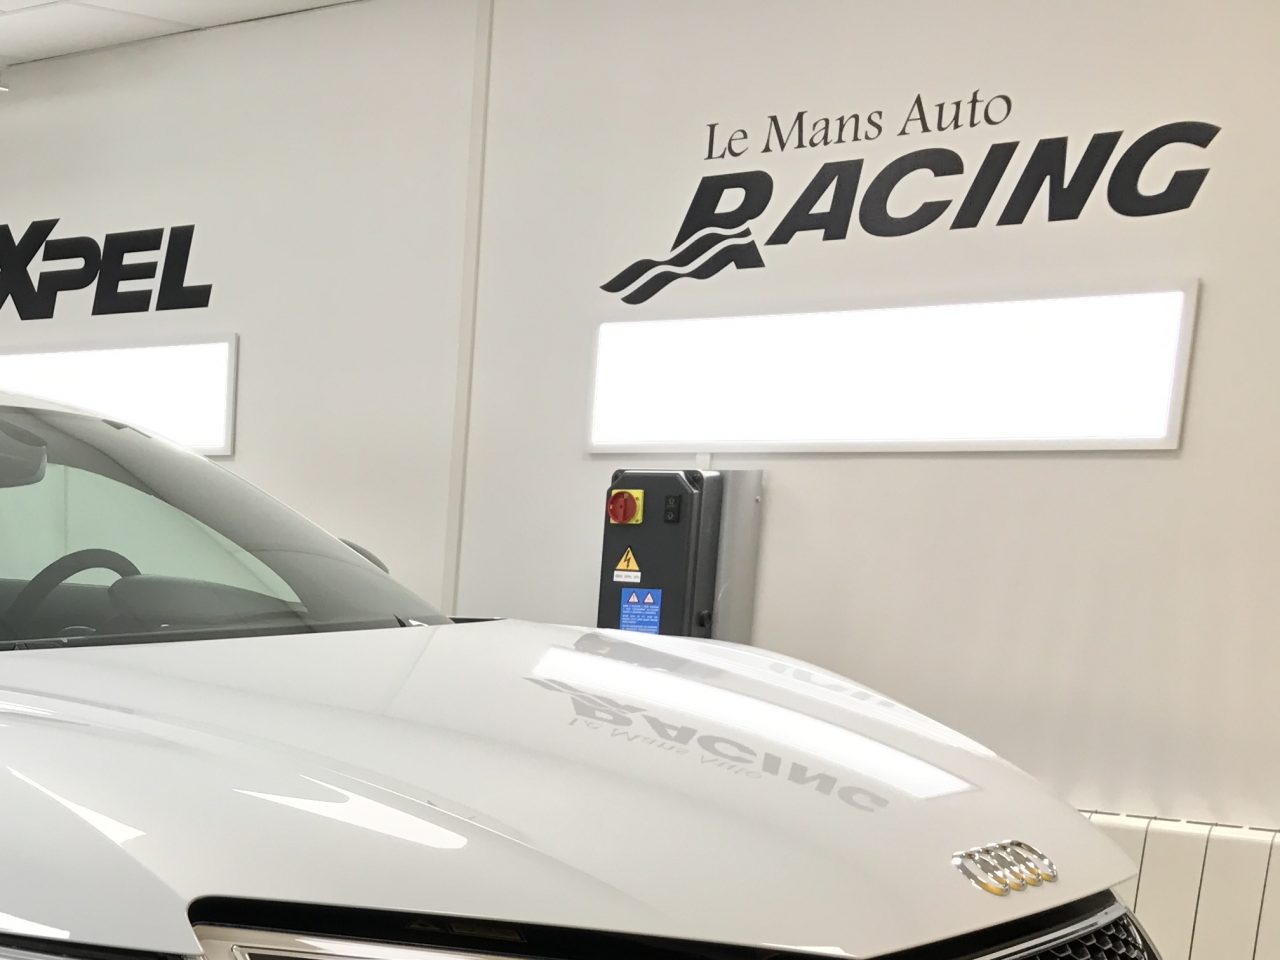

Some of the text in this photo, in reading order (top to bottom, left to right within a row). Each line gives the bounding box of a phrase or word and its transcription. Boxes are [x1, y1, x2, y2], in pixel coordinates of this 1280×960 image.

[704, 89, 1014, 161] Le Mans Auto
[599, 120, 1222, 305] RACING
